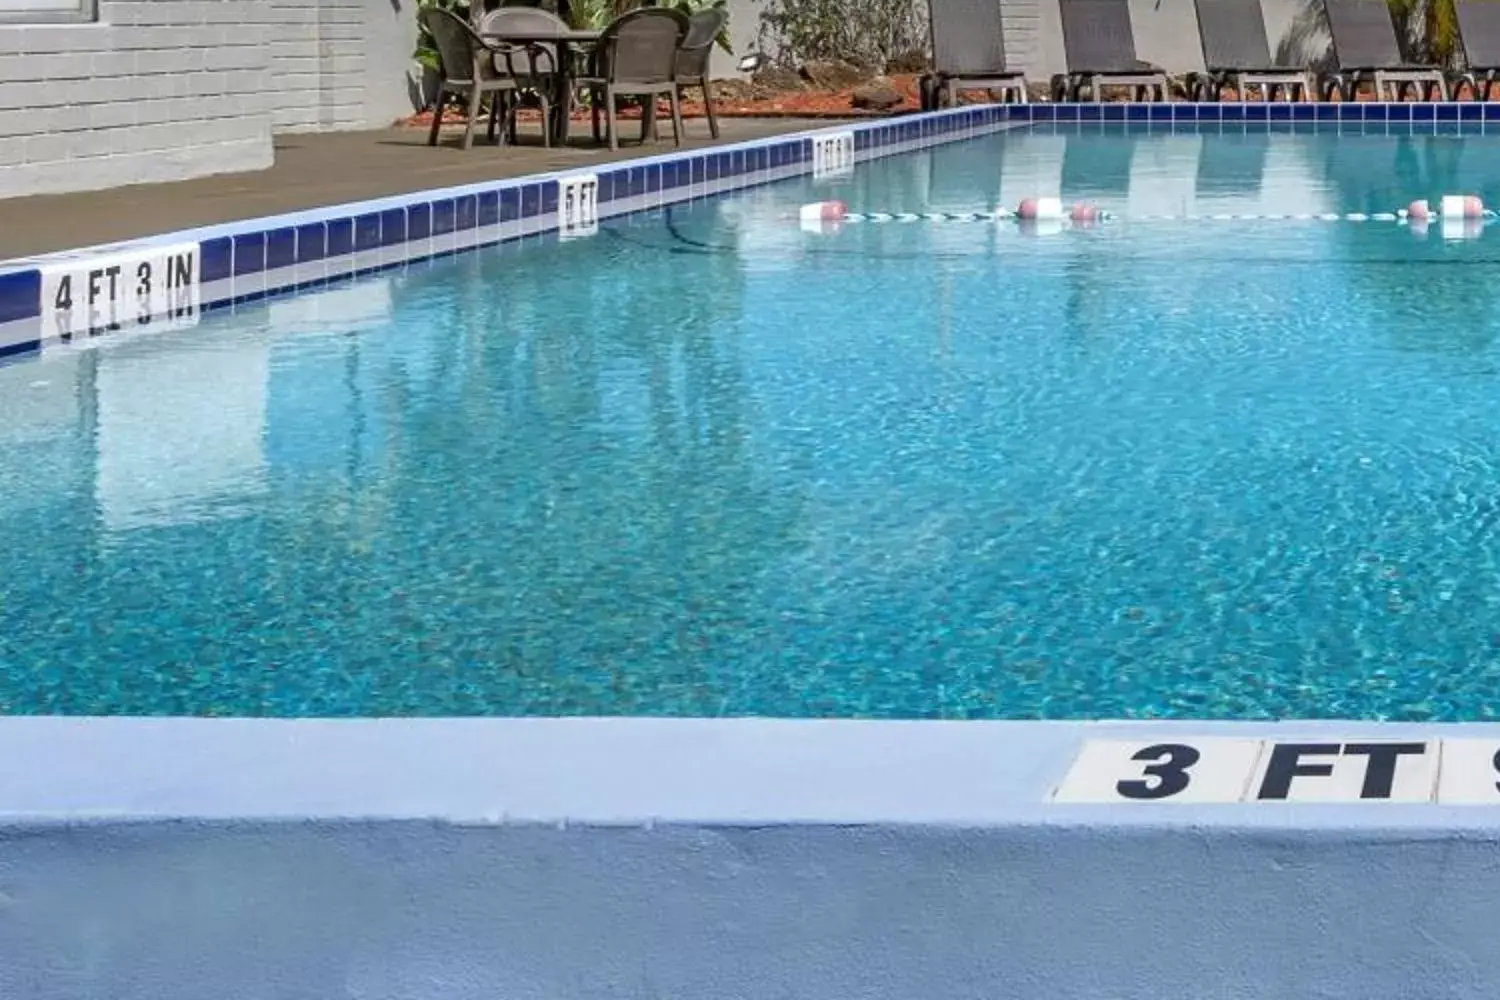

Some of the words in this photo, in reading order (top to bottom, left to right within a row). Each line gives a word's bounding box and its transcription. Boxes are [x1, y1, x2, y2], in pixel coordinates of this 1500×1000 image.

[55, 274, 73, 311] 4
[88, 265, 121, 305] FT
[136, 261, 151, 296] 3
[165, 252, 193, 289] IN
[1115, 743, 1201, 800] 3
[1256, 742, 1427, 801] FT
